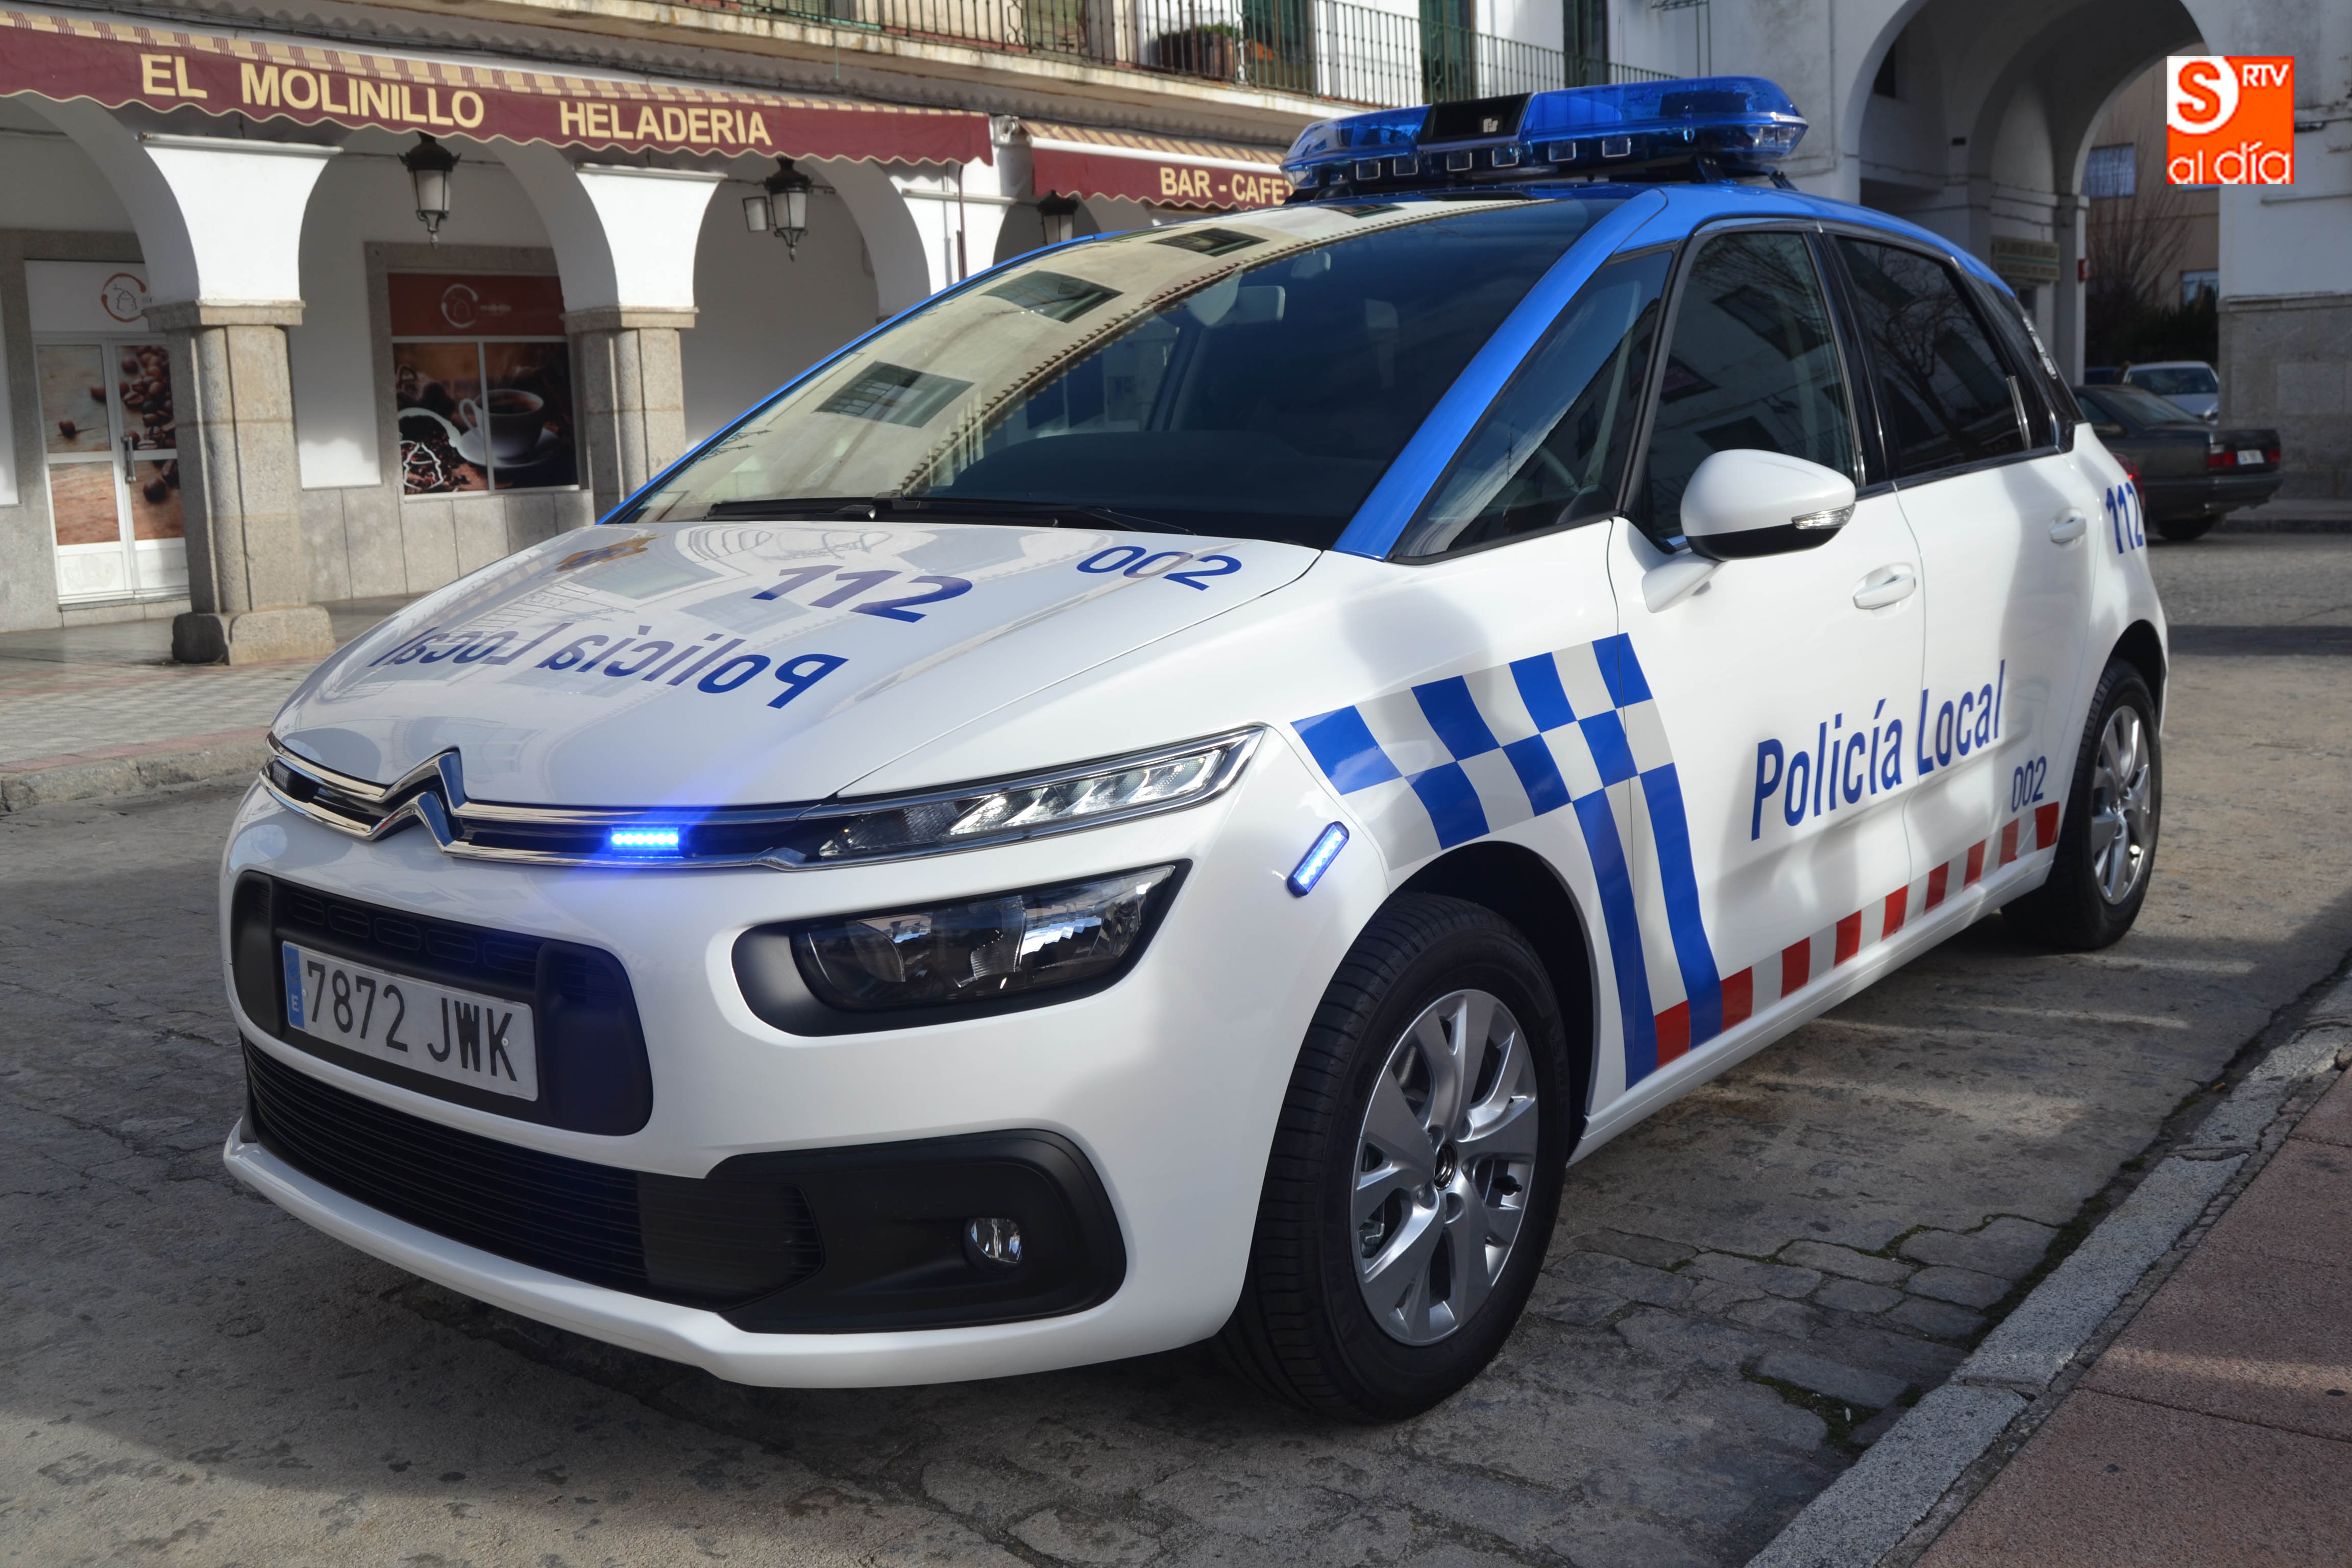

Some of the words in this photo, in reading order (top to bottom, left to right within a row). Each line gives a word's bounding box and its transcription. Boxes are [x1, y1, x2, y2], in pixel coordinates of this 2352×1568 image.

[140, 54, 207, 99] EL
[240, 62, 484, 129] MOLINILLO
[560, 101, 772, 146] HELADERIA
[1160, 167, 1213, 198] BAR
[2106, 482, 2143, 554] 112
[749, 565, 973, 623] 112
[1076, 546, 1242, 591] 002
[1751, 698, 1903, 841] Policía
[1918, 659, 2005, 776] Local
[2012, 756, 2047, 813] 002
[291, 994, 300, 1013] E
[307, 960, 408, 1052] 7872
[427, 997, 518, 1082] JWK
